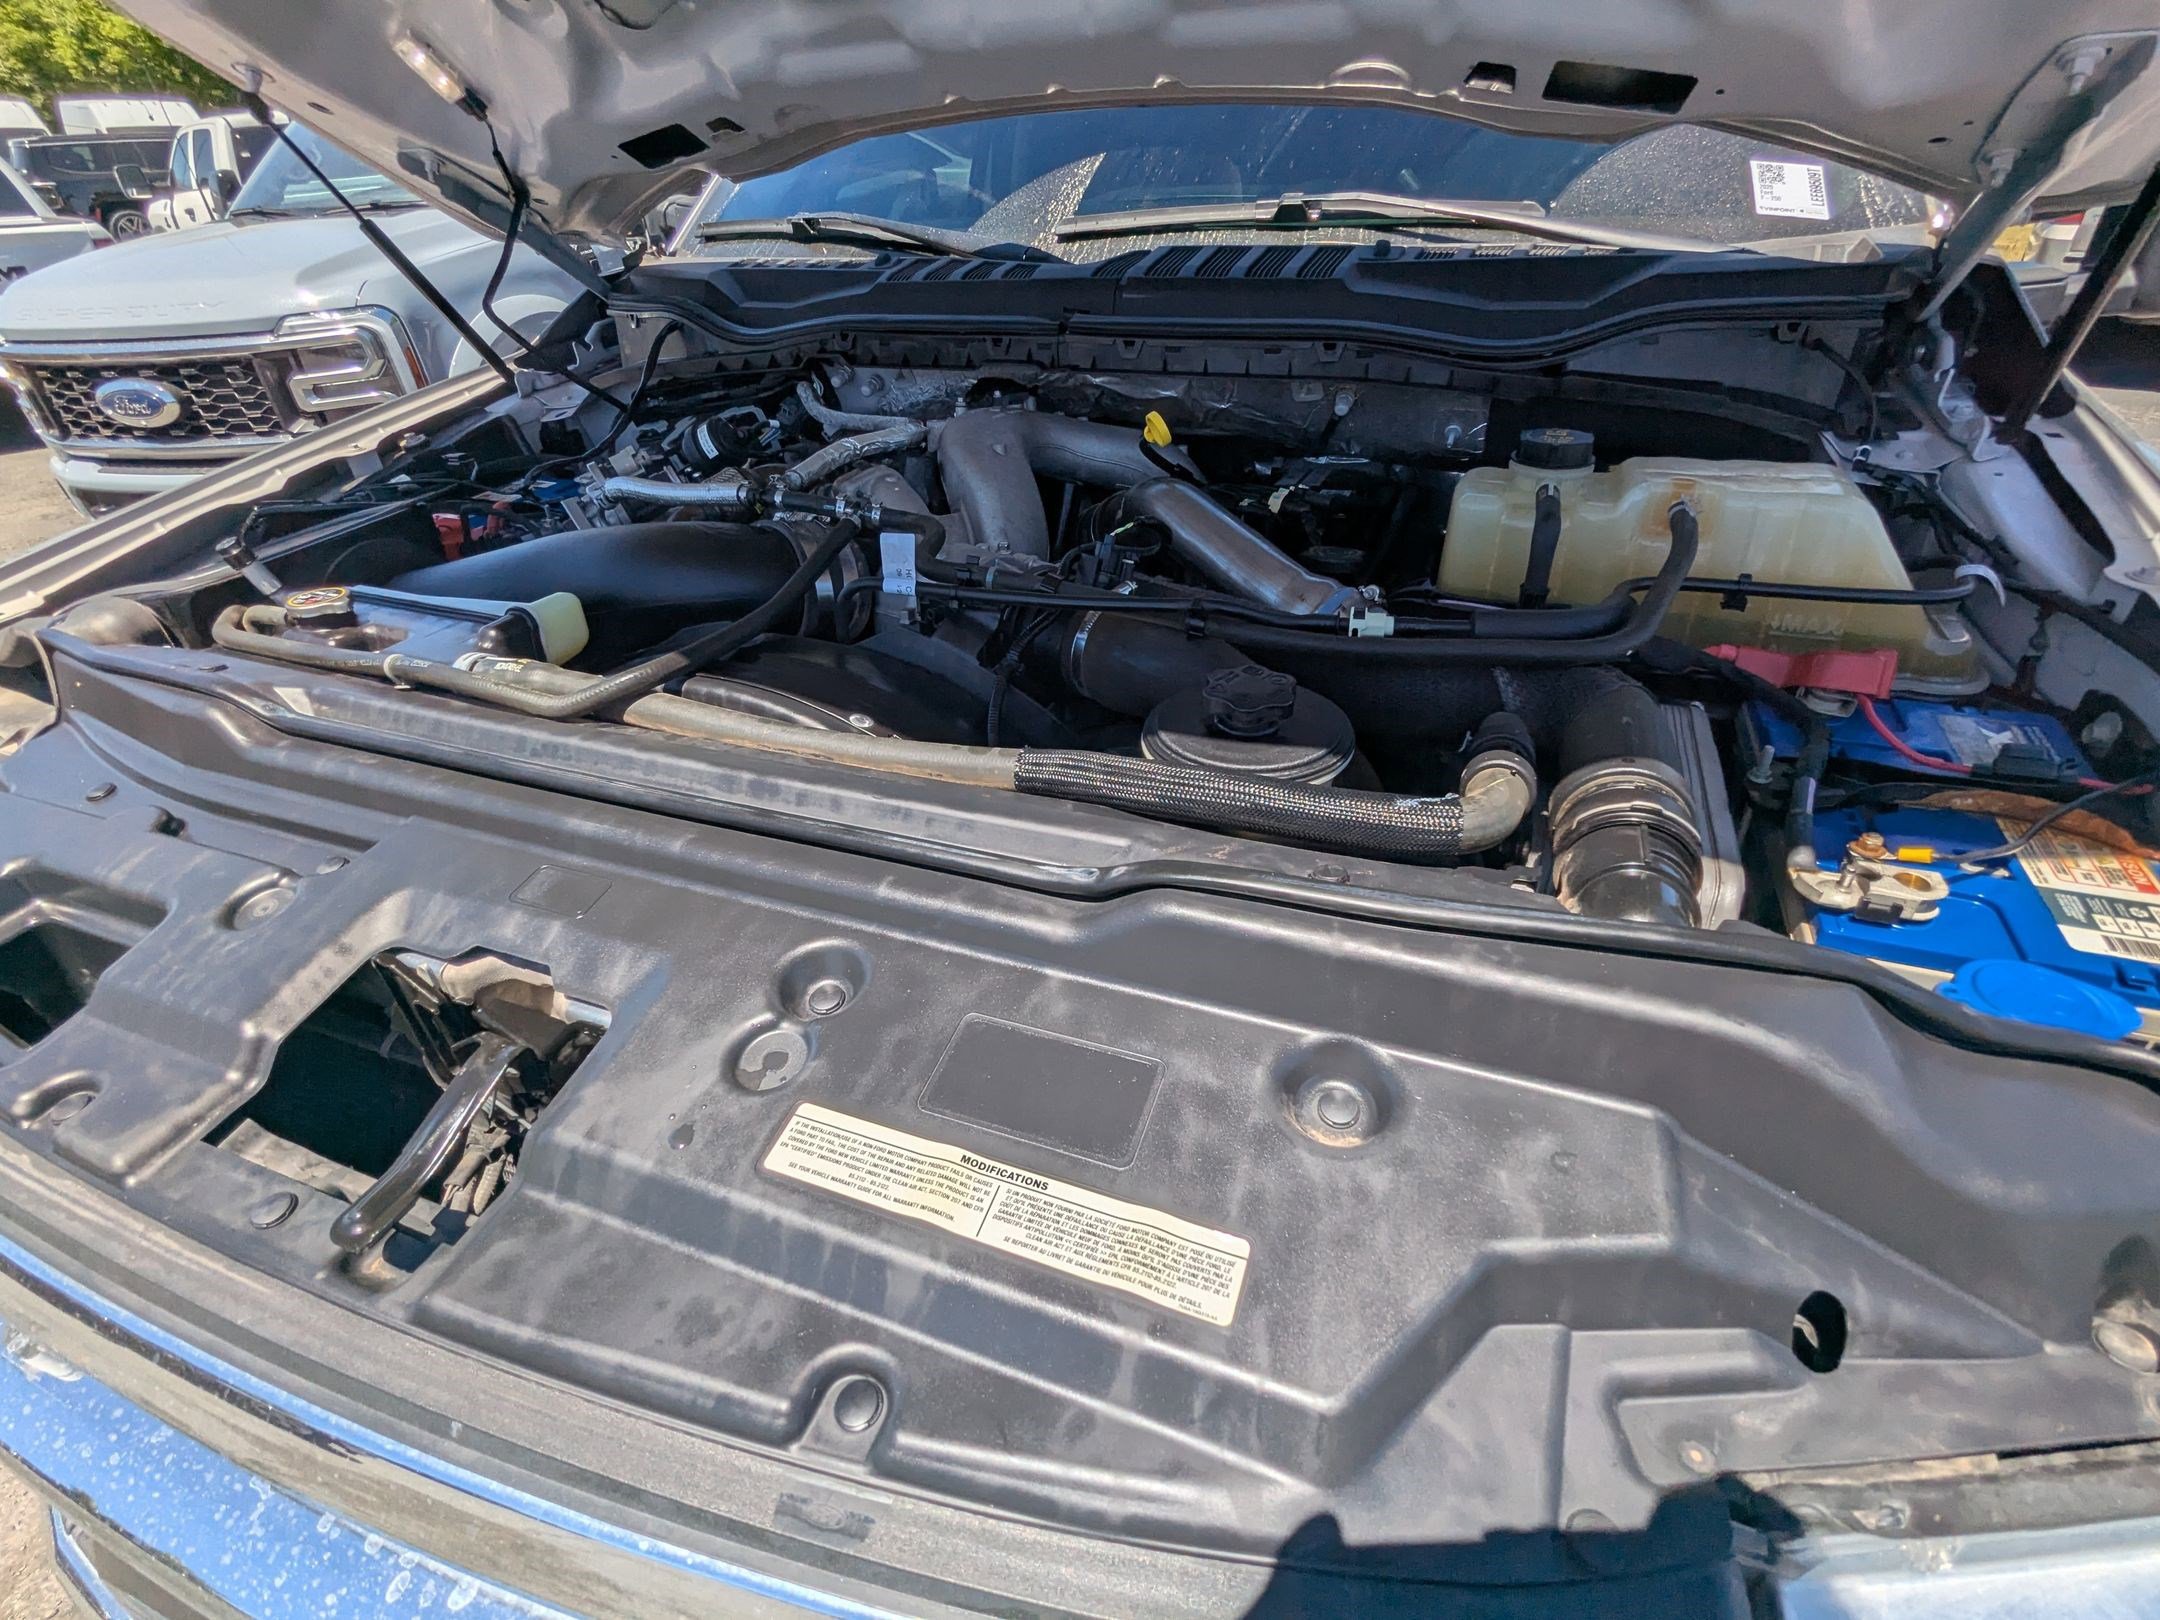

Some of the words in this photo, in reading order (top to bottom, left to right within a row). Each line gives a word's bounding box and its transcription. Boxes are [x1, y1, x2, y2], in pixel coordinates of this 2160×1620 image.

[114, 395, 152, 415] Ford
[787, 1135, 809, 1145] COVERED
[848, 1155, 868, 1164] VEHICLE
[868, 1161, 888, 1170] LIMITED
[888, 1168, 916, 1180] WARRANTY
[915, 1175, 934, 1186] UNLESS
[943, 1184, 969, 1197] PRODUCT
[809, 1125, 851, 1141] INSTALLATION/USE
[862, 1142, 887, 1152] NON-FORD
[886, 1150, 904, 1158] MOTOR
[903, 1155, 927, 1165] COMPANY
[927, 1161, 949, 1172] PRODUCT
[949, 1168, 964, 1176] FAILS
[972, 1177, 993, 1187] CAUSES
[816, 1153, 842, 1164] EMISSIONS
[842, 1161, 864, 1172] PRODUCT
[864, 1169, 881, 1177] UNDER
[891, 1178, 908, 1187] CLEAN
[928, 1188, 950, 1199] SECTION
[949, 1196, 961, 1204] 207
[960, 1201, 973, 1209] AND
[876, 1155, 894, 1164] REPAIR
[916, 1167, 937, 1177] RELATED
[937, 1173, 958, 1183] DAMAGE
[958, 1181, 971, 1189] WILL
[958, 1154, 1050, 1191] MODIFICATIONS
[810, 1169, 830, 1179] VEHICLE
[829, 1176, 856, 1188] WARRANTY
[856, 1185, 871, 1193] GUIDE
[892, 1196, 919, 1209] WARRANTY
[918, 1204, 956, 1221] INFORMATION.
[1019, 1193, 1042, 1203] PRODUIT
[1054, 1204, 1073, 1213] FOURNI
[1093, 1216, 1116, 1227] SOCIÉTÉ
[1131, 1227, 1149, 1236] MOTOR
[1149, 1233, 1177, 1247] COMPANY
[992, 1214, 1023, 1227] DISPOSITIFS
[1023, 1224, 1063, 1241] ANTIPOLLUTION
[1119, 1255, 1166, 1275] CONFORMÉMENT
[997, 1208, 1022, 1219] GARANTIE
[1023, 1216, 1044, 1226] LIMITÉE
[1052, 1225, 1077, 1237] VÉHICULE
[1077, 1234, 1092, 1243] NEUF
[1122, 1248, 1140, 1257] MOINS
[1217, 1281, 1229, 1289] DES
[1025, 1232, 1042, 1242] CLEAN
[1072, 1248, 1084, 1256] AUX
[1026, 1202, 1052, 1214] PRÉSENTE
[1064, 1214, 1098, 1229] DÉFAILLANCE
[1108, 1229, 1125, 1238] CAUSE
[1134, 1235, 1170, 1252] DÉFAILLANCE
[1029, 1210, 1061, 1224] RÉPARATION
[1079, 1227, 1110, 1241] DOMMAGES
[1110, 1236, 1138, 1249] CONNEXES
[1147, 1248, 1170, 1260] SERONT
[1170, 1257, 1181, 1265] PAS
[1182, 1261, 1211, 1275] COUVERTS
[1212, 1271, 1223, 1279] PAR
[1010, 1238, 1038, 1251] REPORTER
[1046, 1250, 1065, 1261] LIVRET
[1074, 1260, 1101, 1272] GARANTIE
[1110, 1270, 1136, 1283] VÉHICULE
[1137, 1279, 1153, 1289] POUR
[1153, 1287, 1168, 1296] PLUS
